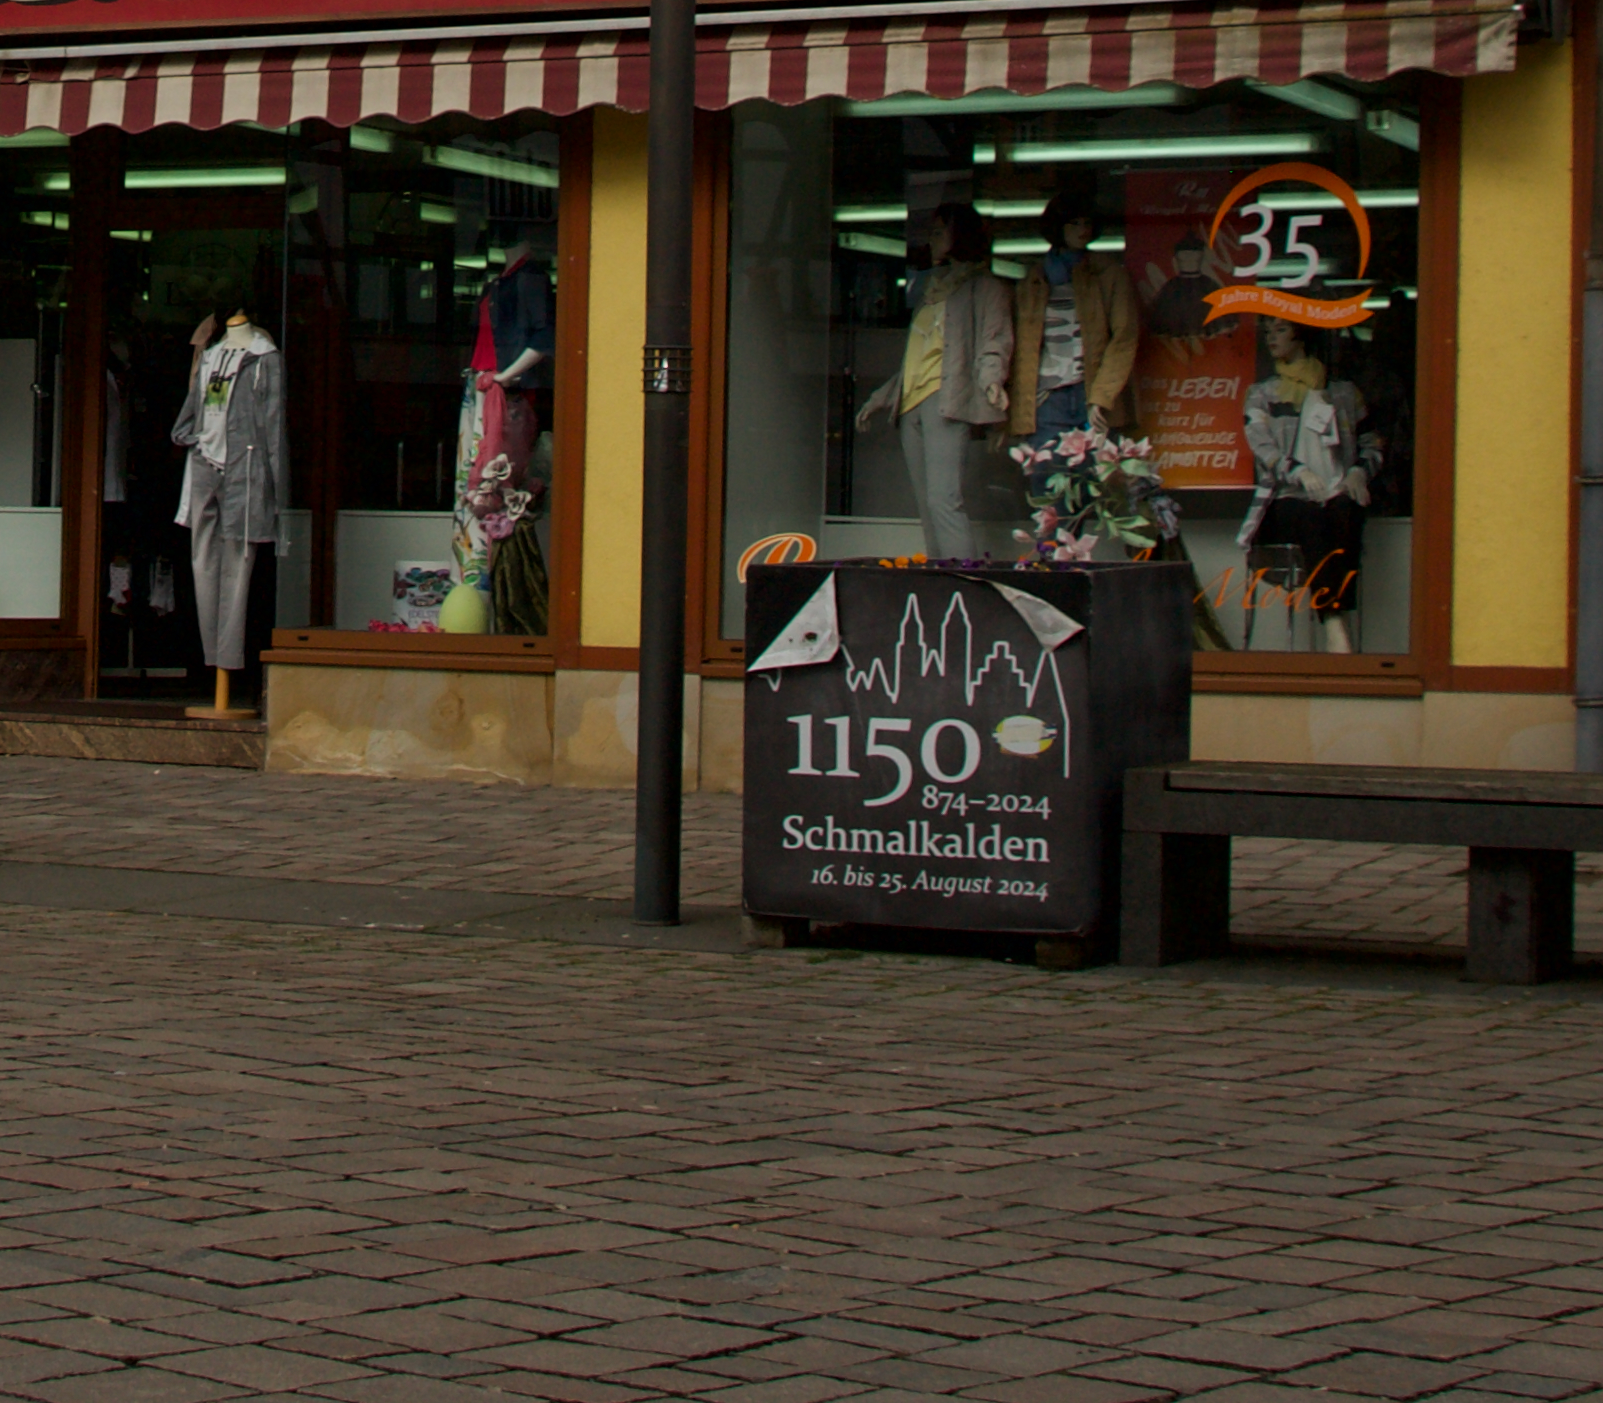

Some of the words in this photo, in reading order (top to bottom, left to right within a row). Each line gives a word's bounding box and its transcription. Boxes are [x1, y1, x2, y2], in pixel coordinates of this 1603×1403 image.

[1232, 203, 1324, 288] 35
[1218, 289, 1260, 309] Jahre
[1262, 290, 1304, 316] Royal
[1306, 303, 1358, 321] Moden
[1164, 401, 1182, 413] zu
[1167, 376, 1241, 400] LEBEN
[1191, 412, 1216, 430] für
[1192, 547, 1359, 610] Mode!
[786, 713, 982, 808] 1150
[782, 814, 1051, 863] Schmalkalden
[810, 864, 838, 886] 16.
[843, 863, 875, 887] bis
[880, 873, 907, 895] 25.
[910, 869, 993, 898] August
[997, 878, 1050, 903] 2024
